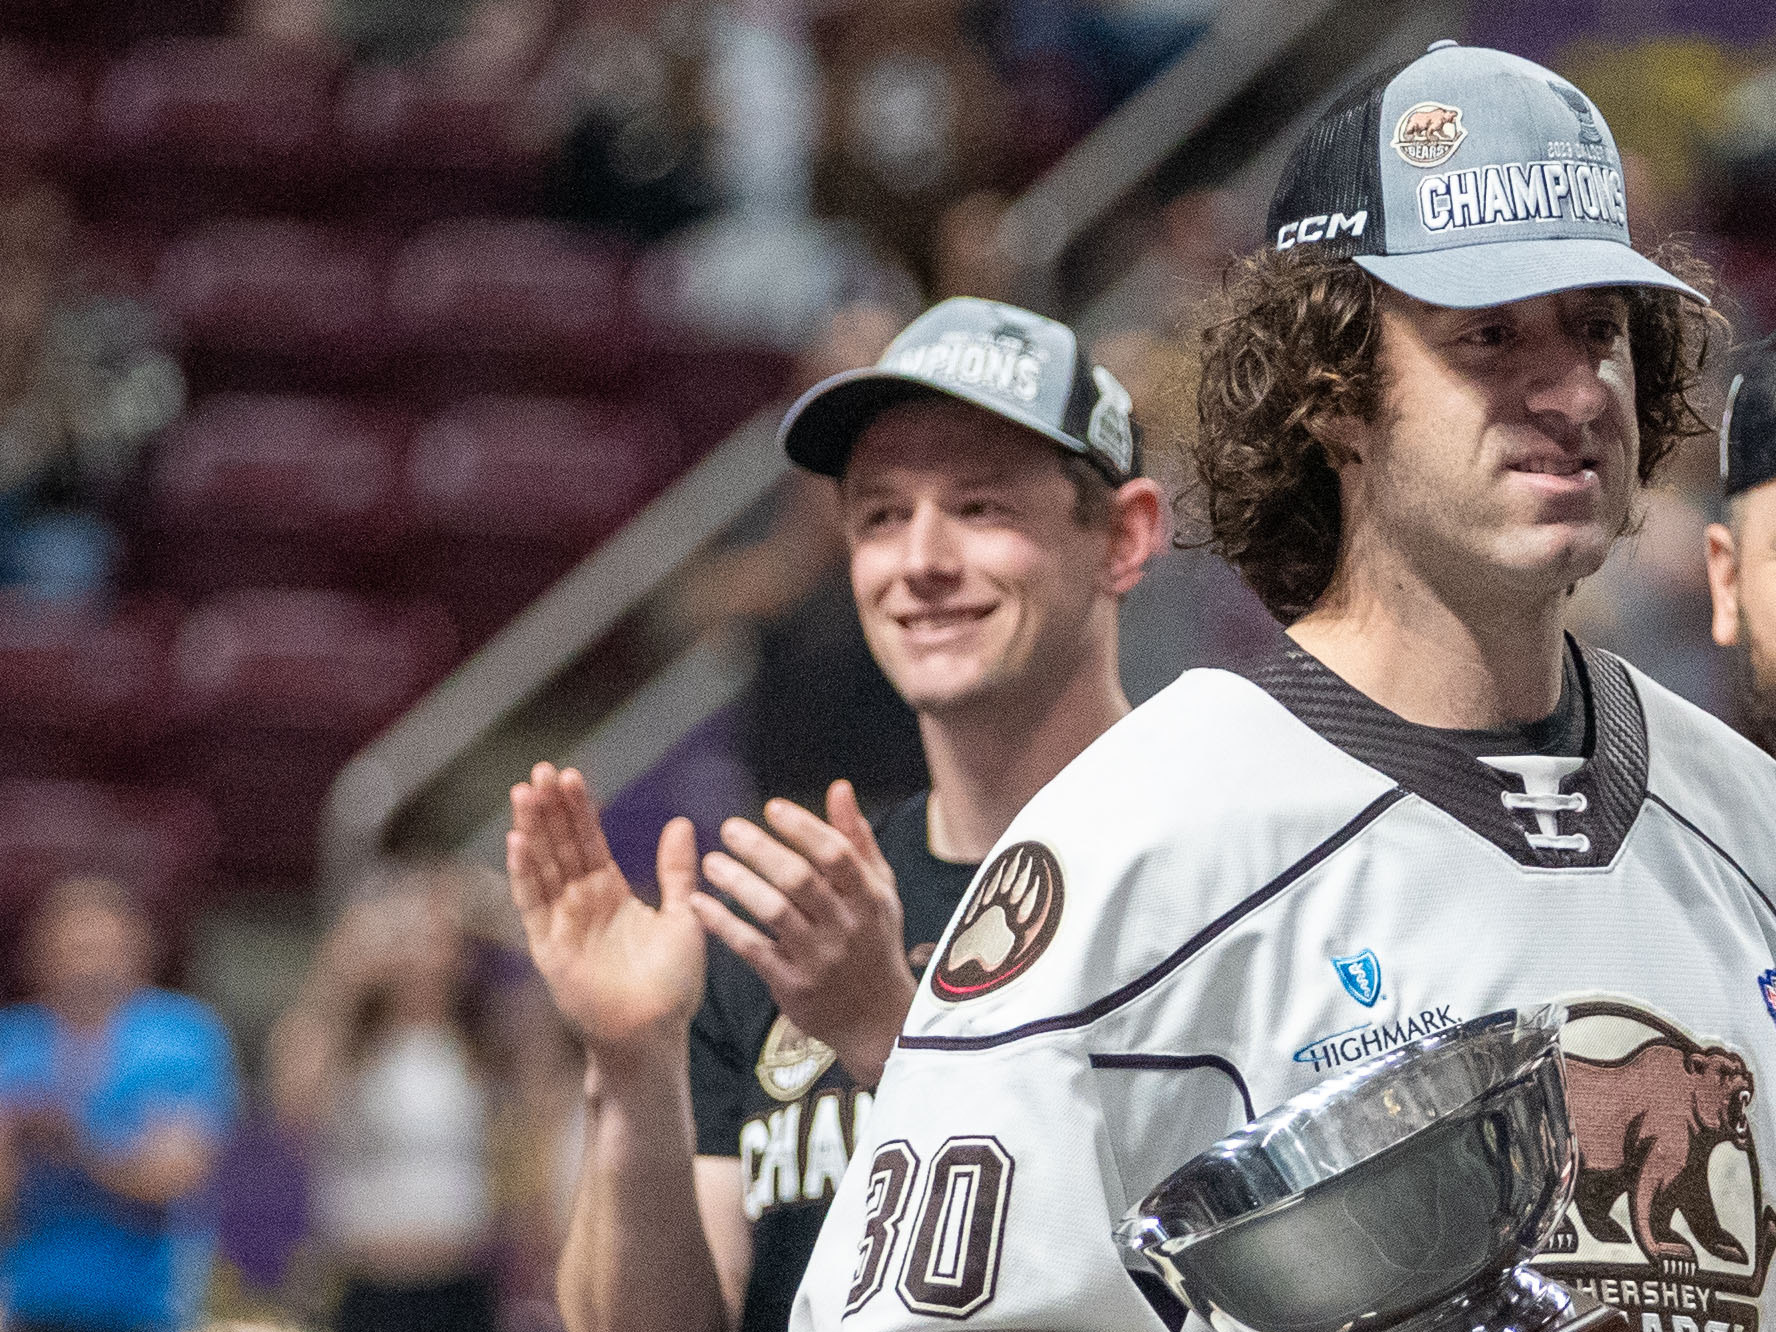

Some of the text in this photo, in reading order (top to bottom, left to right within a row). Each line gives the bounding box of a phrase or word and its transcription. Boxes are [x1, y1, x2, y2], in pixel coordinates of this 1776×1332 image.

[1420, 162, 1625, 231] CHAMPIONS
[1276, 210, 1368, 252] CCM
[842, 1133, 1015, 1322] 30
[1576, 1278, 1710, 1313] HERSHEY
